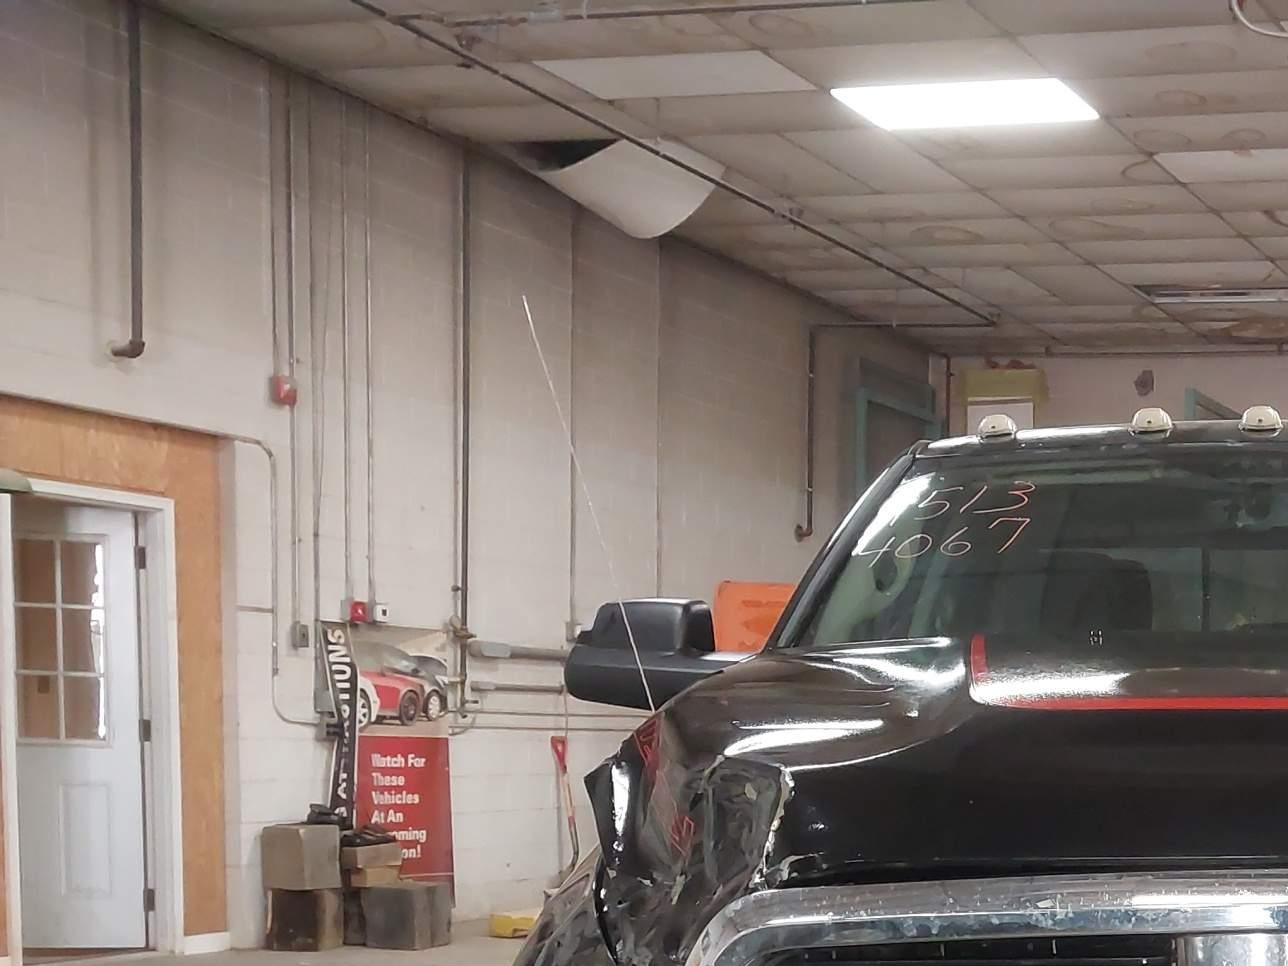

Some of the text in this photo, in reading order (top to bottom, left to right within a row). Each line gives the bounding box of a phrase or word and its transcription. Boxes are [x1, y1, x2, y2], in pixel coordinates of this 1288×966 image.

[858, 526, 1032, 568] 4067
[371, 753, 426, 767] Watch For
[371, 772, 405, 786] These
[371, 790, 420, 805] Vehicles
[371, 809, 404, 824] At An
